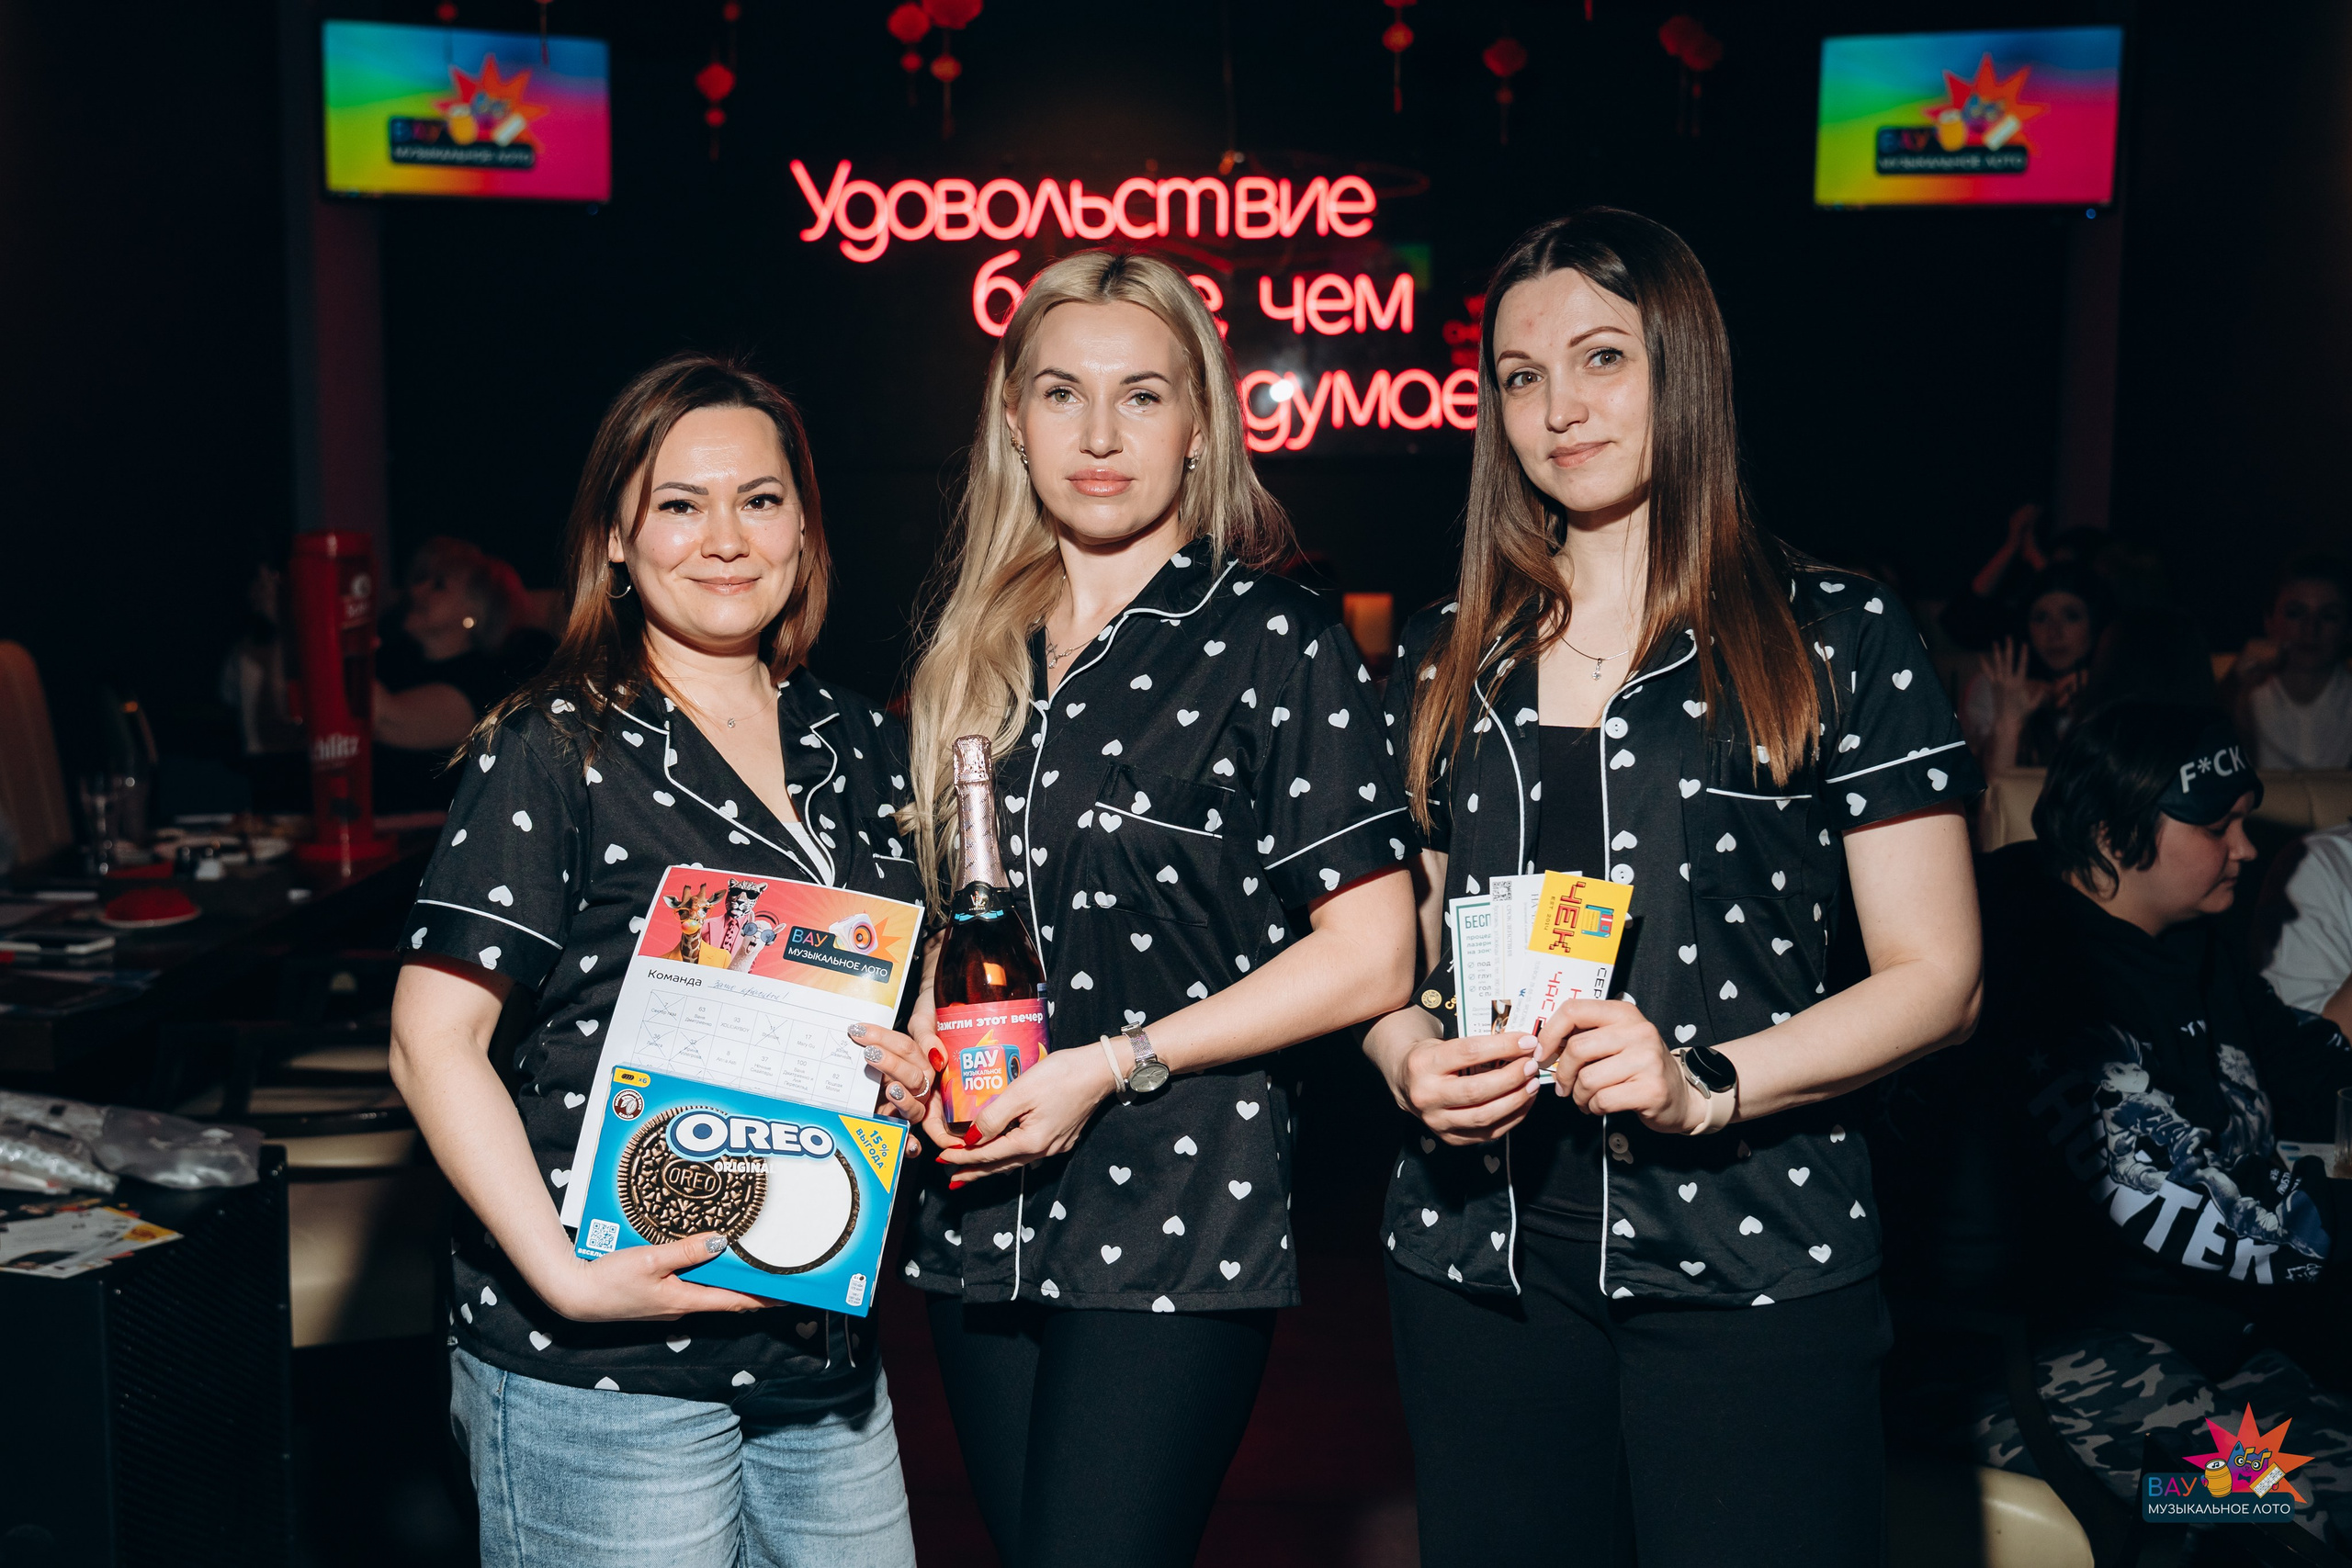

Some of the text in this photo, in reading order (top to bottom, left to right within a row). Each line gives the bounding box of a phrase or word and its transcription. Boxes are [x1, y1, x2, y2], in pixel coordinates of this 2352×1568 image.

[790, 159, 1378, 263] Удовольствие
[1259, 273, 1415, 336] чем
[1549, 881, 1587, 953] ЧЕК
[791, 929, 829, 948] ВАУ
[787, 946, 888, 977] МУЗЫКАЛЬНОЕ ЛОТО
[648, 969, 703, 987] Команда
[937, 1012, 1044, 1032] Зажгли этот вечер
[962, 1049, 999, 1070] ВАУ
[963, 1068, 1001, 1077] МУЗЫКАЛЬНОЕ
[964, 1075, 1003, 1091] ЛОТО
[672, 1111, 835, 1157] OREO
[855, 1128, 884, 1170] ВЫГОДА
[668, 1167, 717, 1193] OREO
